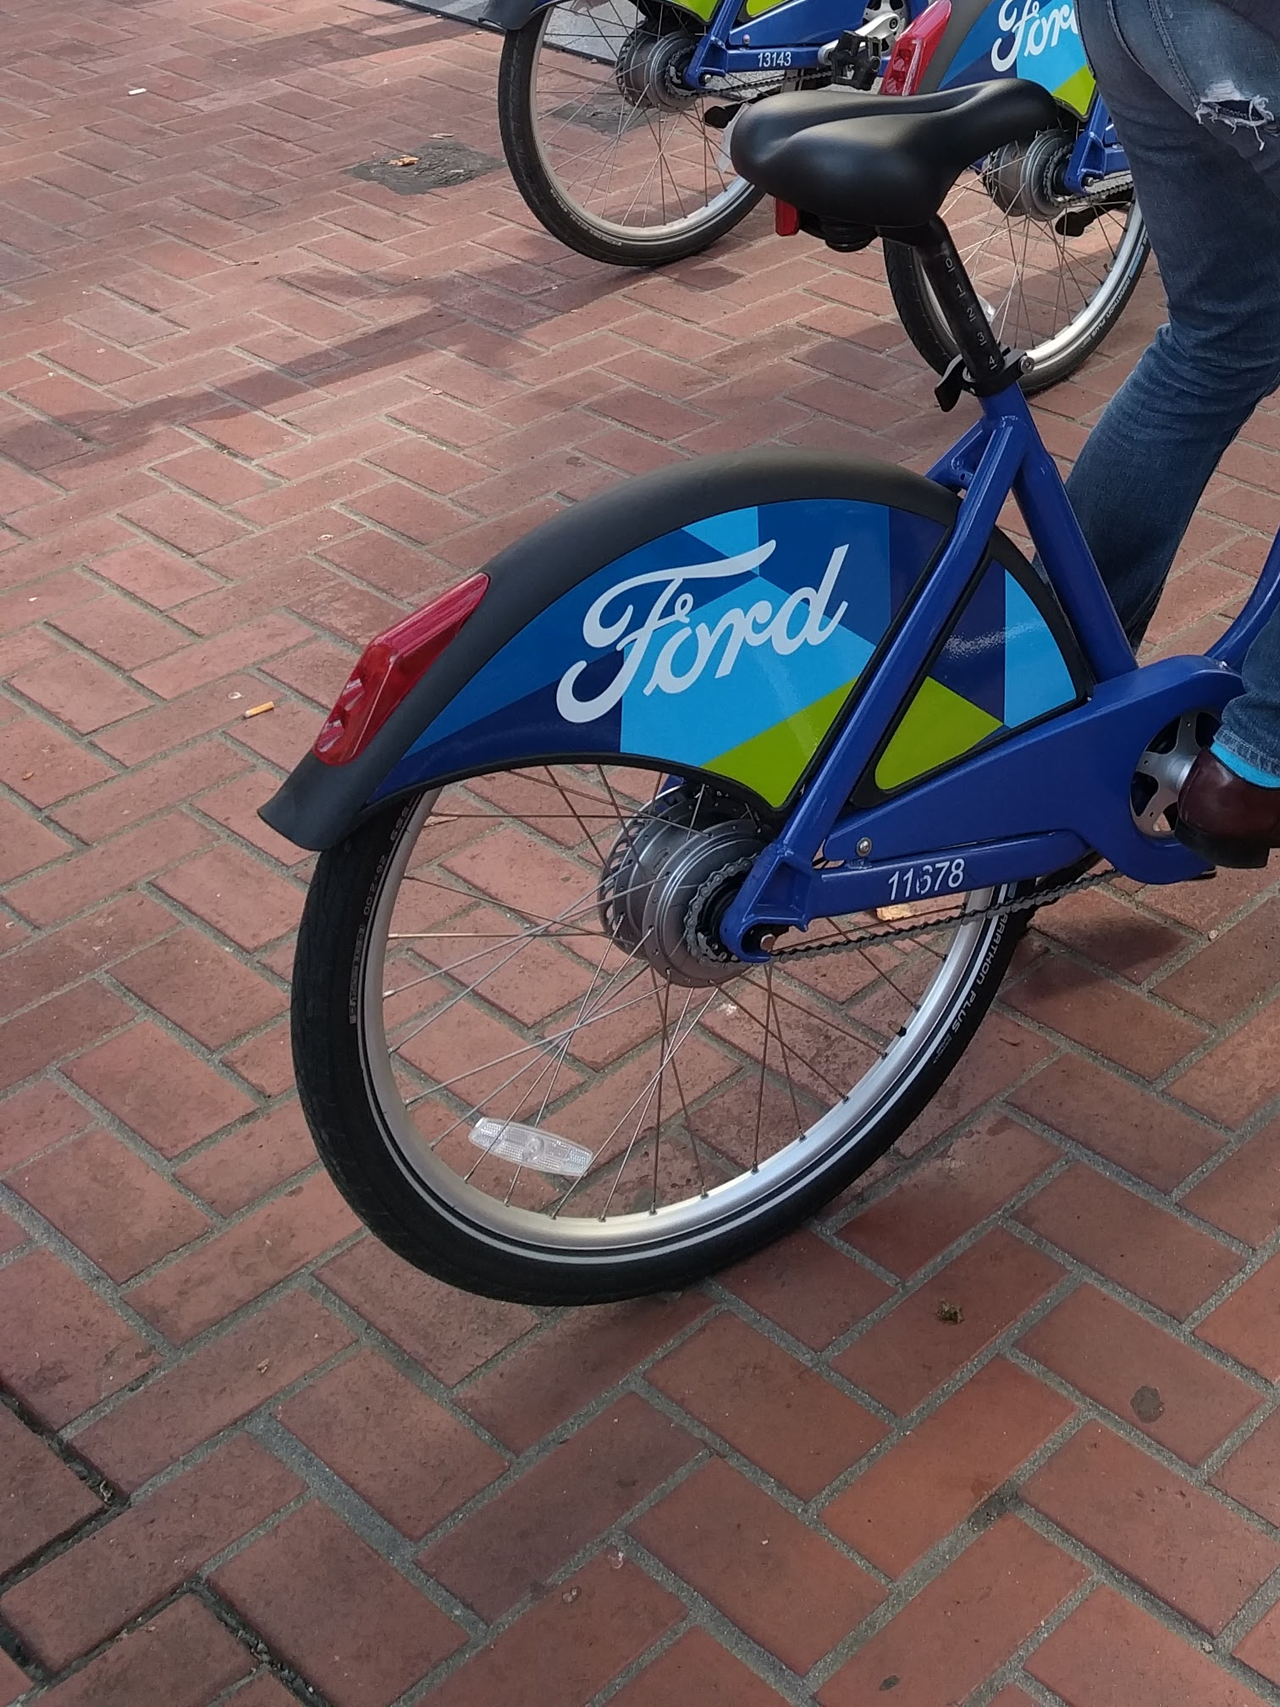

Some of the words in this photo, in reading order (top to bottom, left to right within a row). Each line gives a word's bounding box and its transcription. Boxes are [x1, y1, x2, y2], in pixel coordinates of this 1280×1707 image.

[757, 51, 792, 68] 13143
[556, 538, 849, 724] Ford
[887, 858, 965, 901] 11678
[976, 912, 1009, 986] ARATHON
[951, 989, 977, 1033] PLUS
